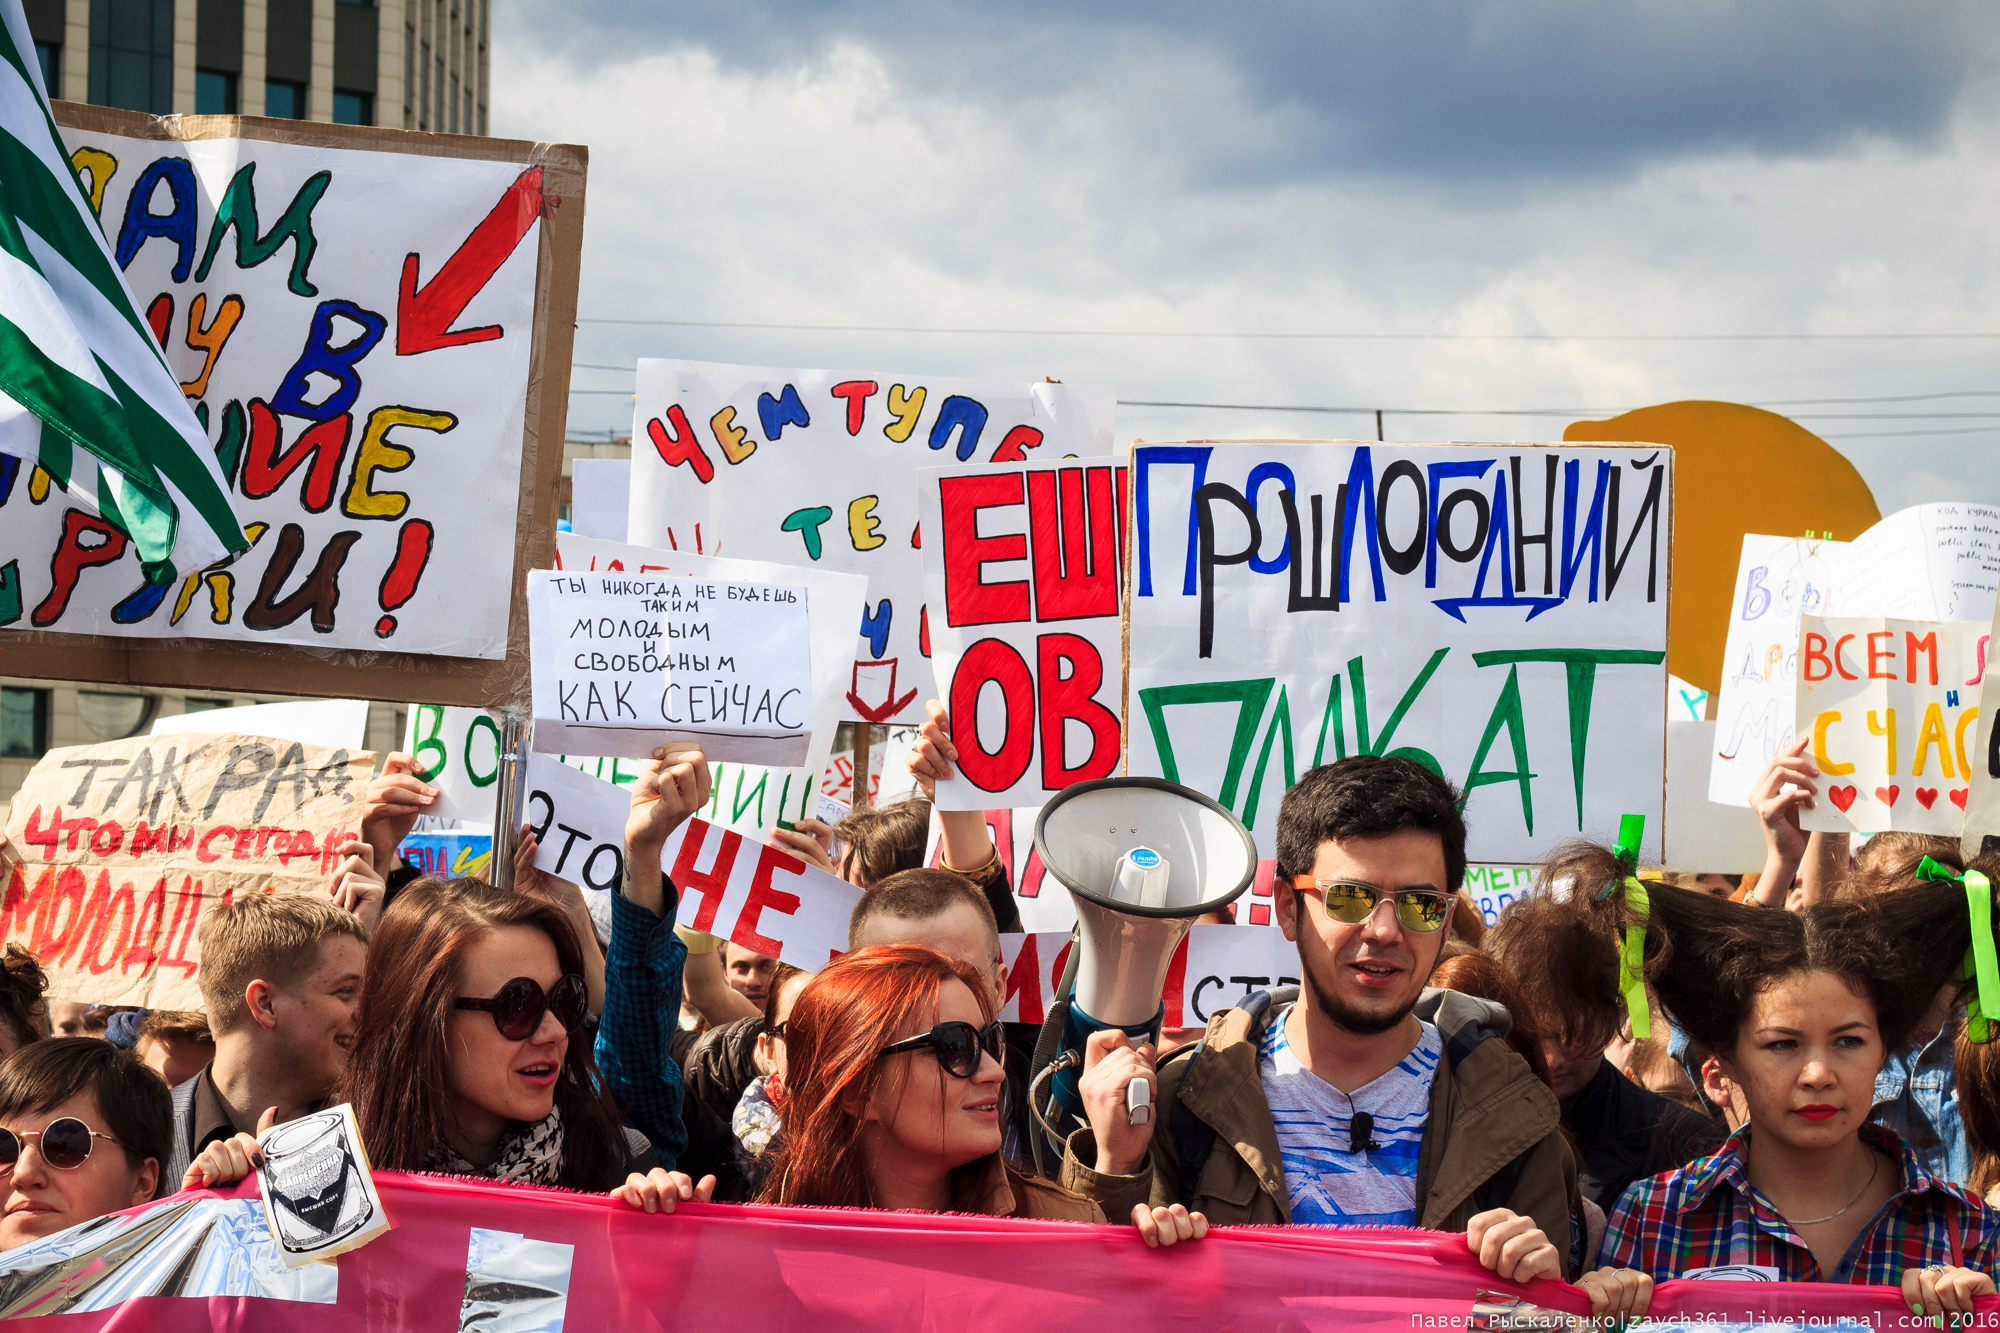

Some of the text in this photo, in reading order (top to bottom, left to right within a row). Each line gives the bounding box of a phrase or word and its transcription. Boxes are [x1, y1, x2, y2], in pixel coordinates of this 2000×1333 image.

[647, 384, 811, 484] ЧЕМ
[1967, 507, 2000, 521] КУРИЛЬ
[939, 465, 1128, 628] ЕШ
[1135, 446, 1664, 659] ПРОШЛОГОДНИЙ
[1937, 539, 1992, 550] public class
[1956, 551, 1982, 563] public
[550, 578, 797, 604] ТЫ НИКОГДА НЕ БУДЕШЬ
[640, 599, 699, 613] ТАКИМ
[569, 617, 711, 641] МОЛОДЫМ
[574, 652, 735, 673] СВОБОДНЫМ
[1803, 630, 1939, 686] ВСЕМ
[558, 679, 804, 729] КАК СЕЙЧАС
[61, 745, 214, 824] ТАК
[24, 803, 358, 876] ЧТО МЫ СЕГОДН
[530, 789, 624, 891] ЭТО
[669, 816, 807, 960] НЕ
[280, 1152, 340, 1189] ЗАПРЕЩЕНКА
